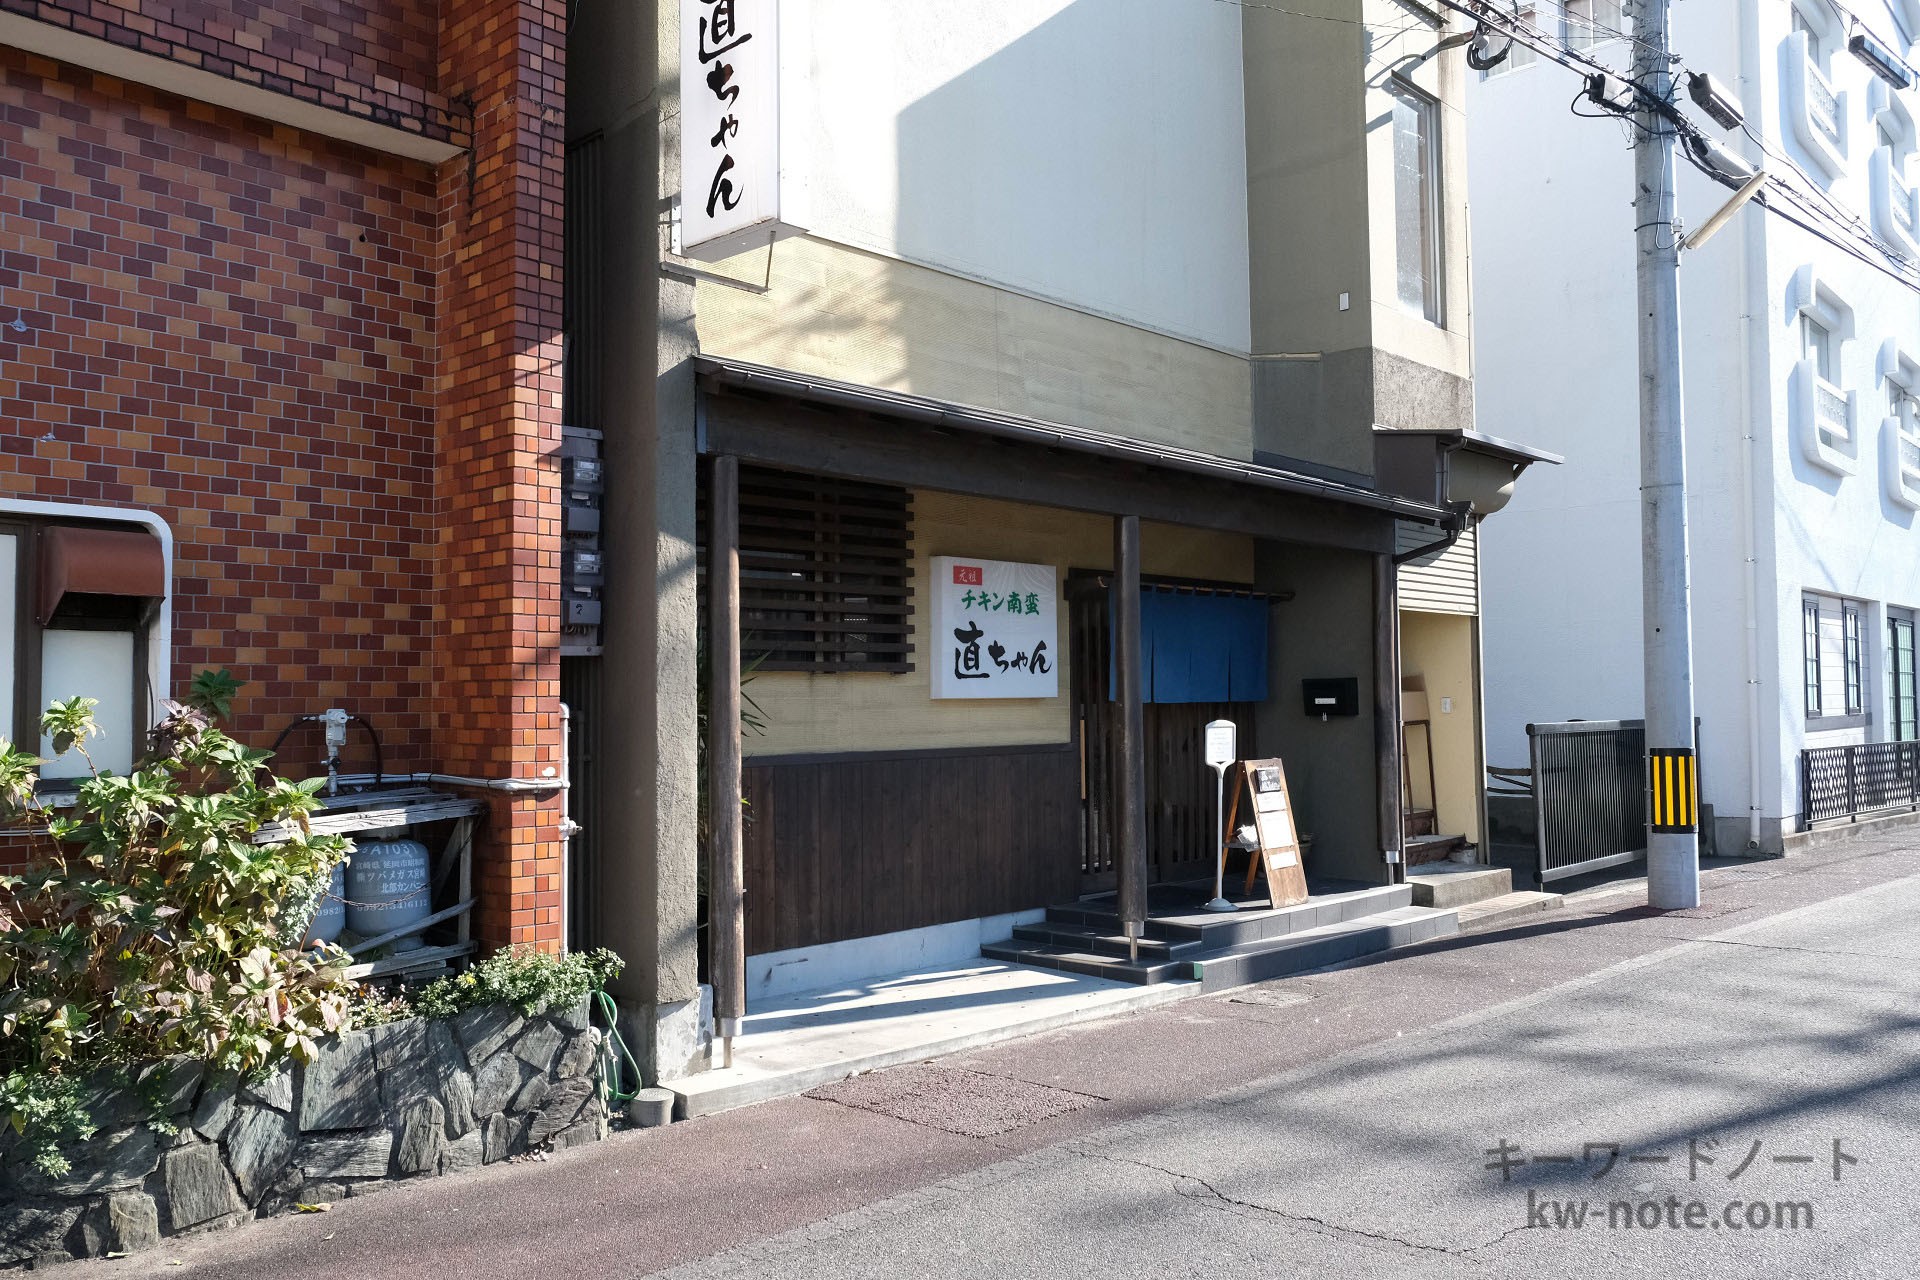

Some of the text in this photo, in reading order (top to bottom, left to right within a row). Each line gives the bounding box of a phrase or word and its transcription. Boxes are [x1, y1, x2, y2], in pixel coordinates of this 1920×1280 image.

[961, 589, 1040, 615] チキン南蛮
[954, 620, 1052, 679] 直ちゃん
